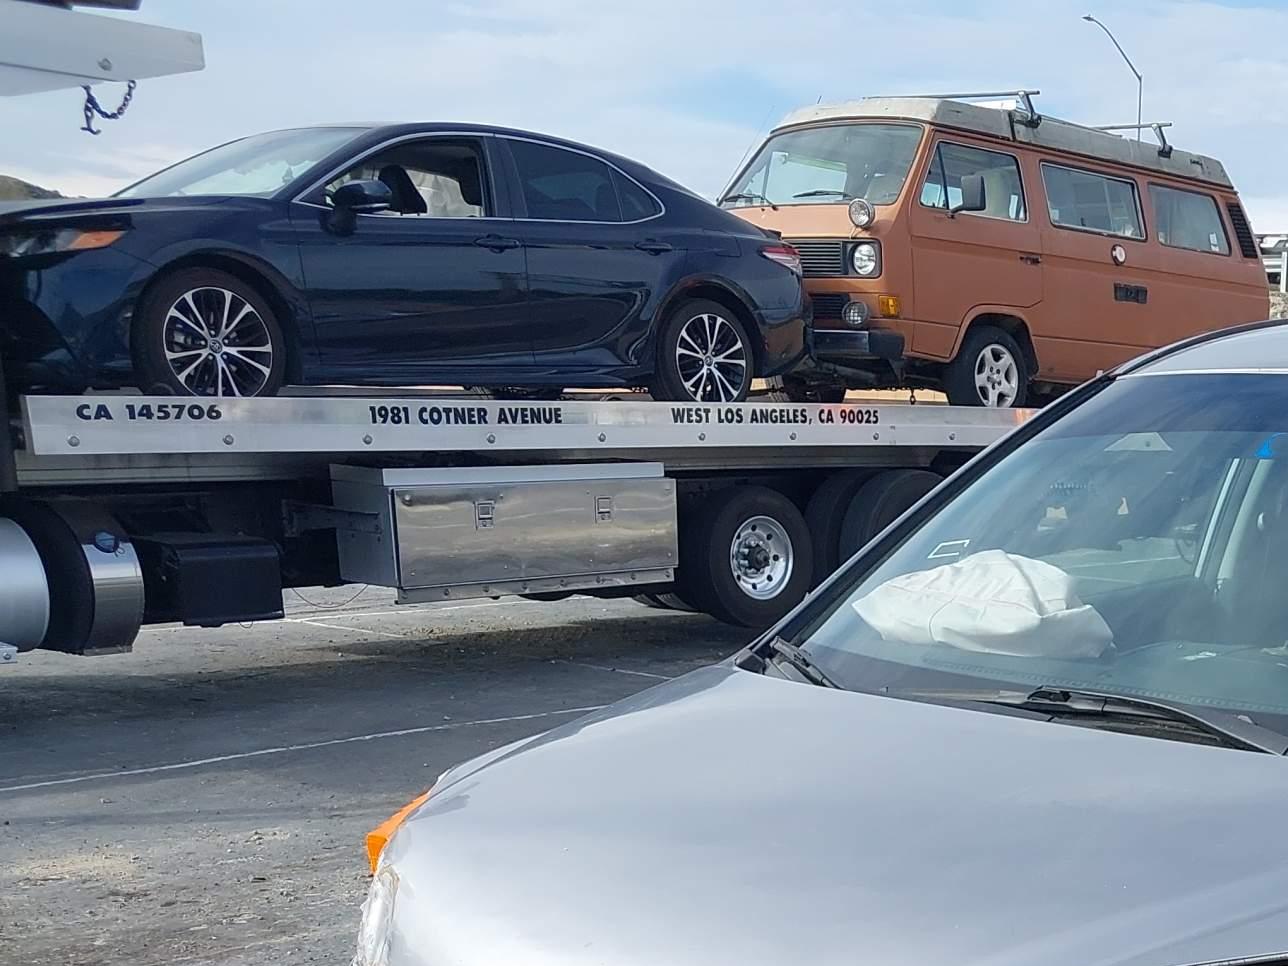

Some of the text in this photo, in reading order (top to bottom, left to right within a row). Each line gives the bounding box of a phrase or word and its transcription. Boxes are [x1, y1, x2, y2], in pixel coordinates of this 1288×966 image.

[75, 403, 222, 421] CA 145706
[369, 405, 563, 426] 1981 COTNER AVENUE
[671, 407, 879, 425] WEST LOS ANGELES, CA 90025
